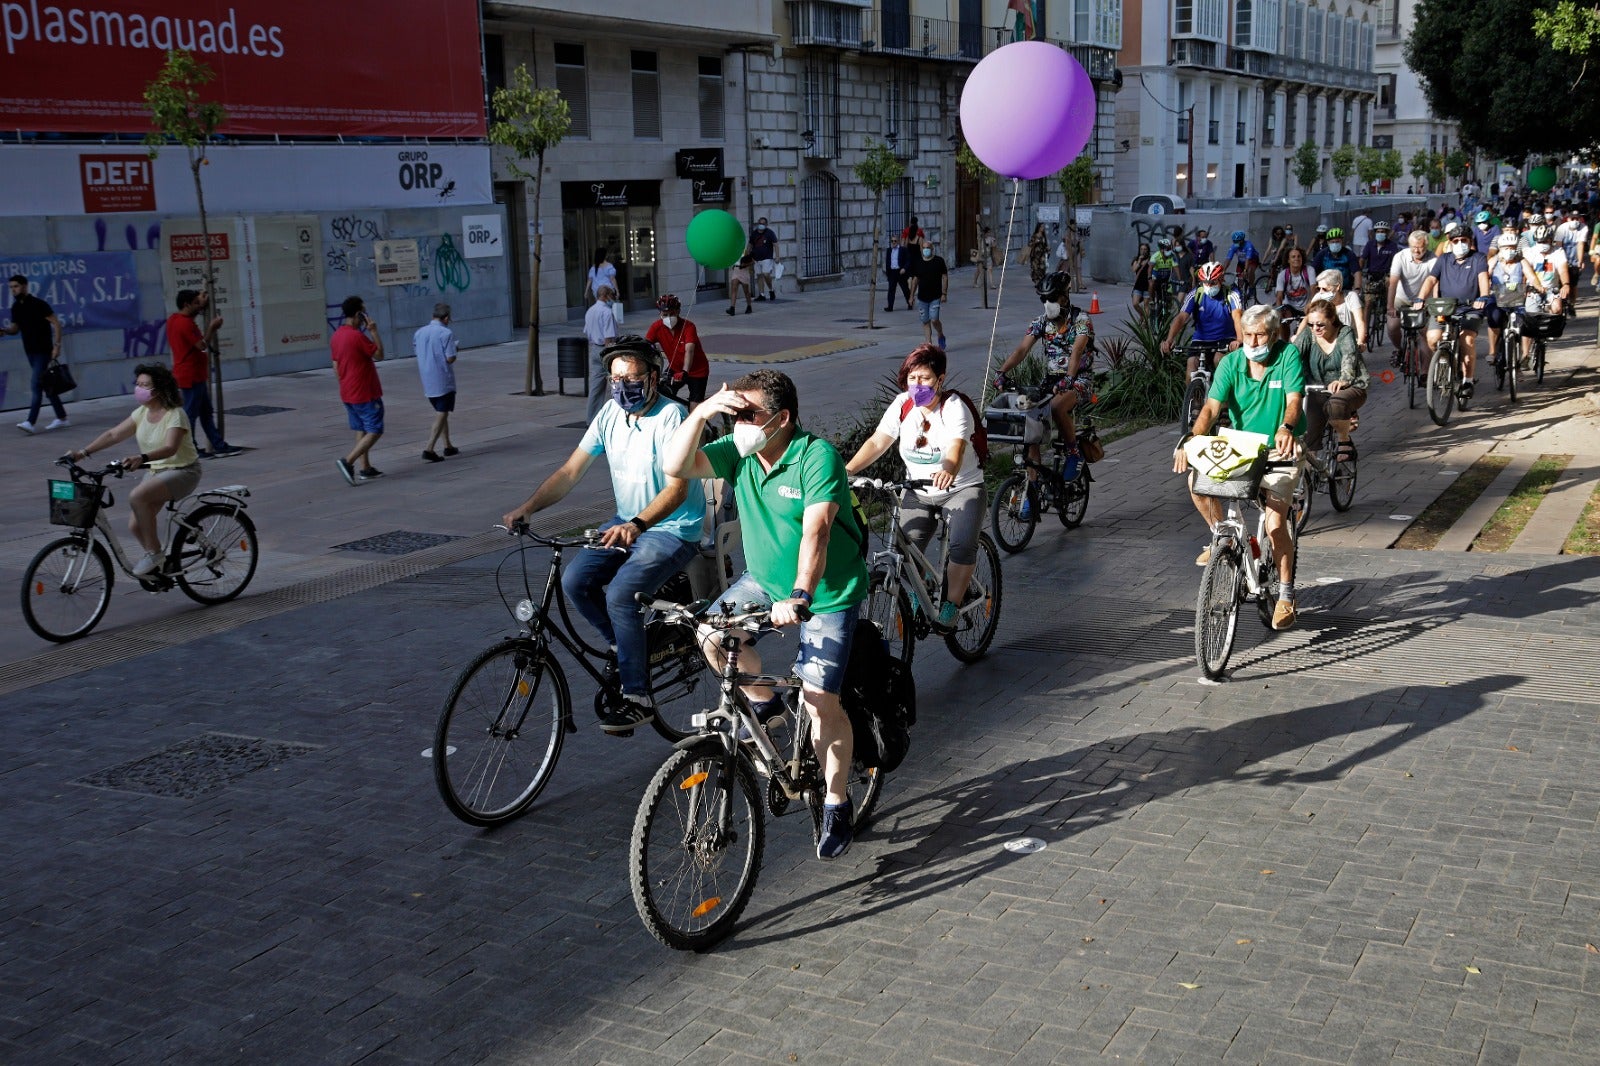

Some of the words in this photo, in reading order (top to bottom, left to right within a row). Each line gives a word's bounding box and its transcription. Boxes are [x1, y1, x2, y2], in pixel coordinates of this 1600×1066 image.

[2, 0, 286, 62] plasmaquad.es
[398, 151, 428, 162] GRUPO
[85, 161, 150, 186] DEFI
[399, 163, 443, 191] ORP
[172, 234, 222, 247] HIPOTEAS
[468, 231, 490, 245] ORP
[173, 247, 227, 260] SANTADER
[0, 259, 87, 278] TRUCTURAS
[92, 275, 136, 302] S.L.
